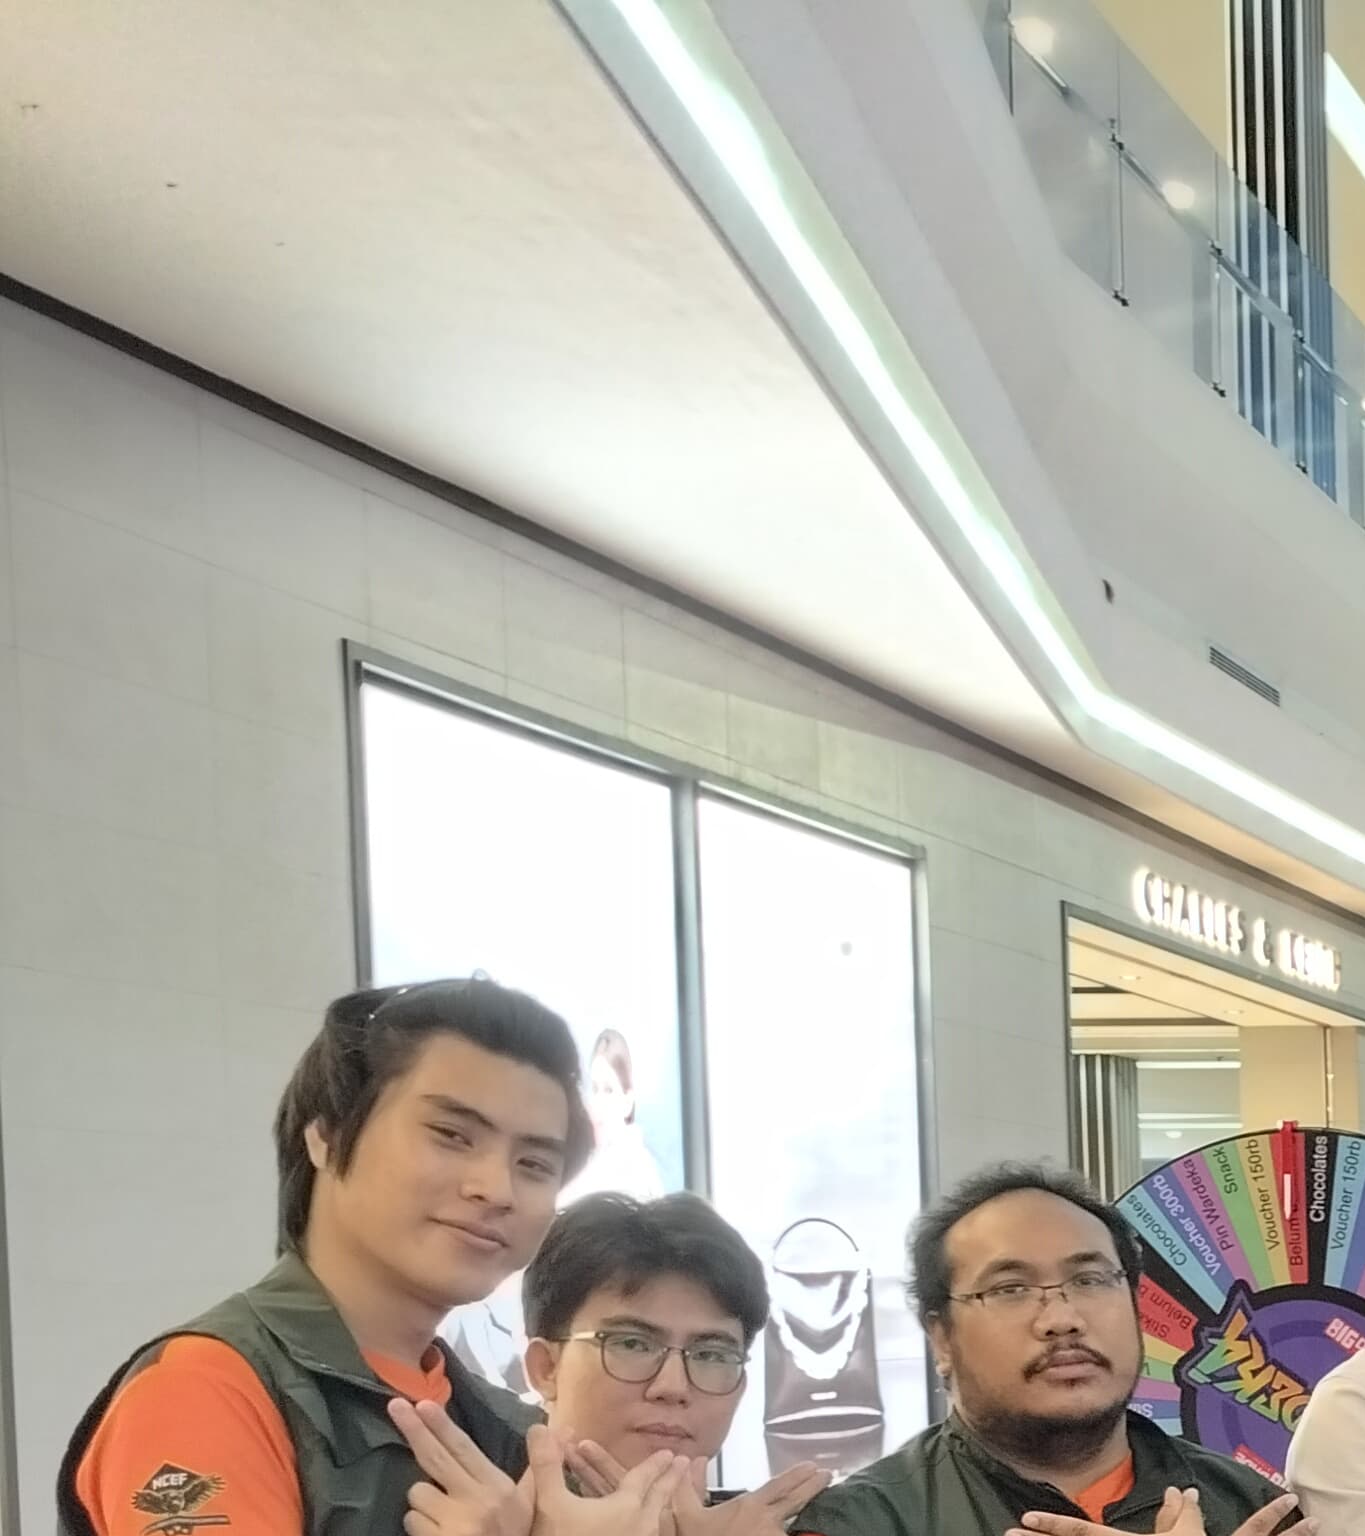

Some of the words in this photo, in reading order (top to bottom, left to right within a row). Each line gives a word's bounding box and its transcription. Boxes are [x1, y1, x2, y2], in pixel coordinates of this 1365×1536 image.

[1212, 1146, 1239, 1195] Snack
[1245, 1138, 1265, 1183] 150rb
[1309, 1135, 1329, 1223] Chocolates
[1152, 1174, 1185, 1217] 300rb
[1183, 1158, 1220, 1225] Wardeka
[1257, 1188, 1281, 1250] Voucher
[1331, 1189, 1354, 1251] Voucher
[1343, 1140, 1362, 1183] 150rb
[1126, 1194, 1188, 1266] Chocolates
[1180, 1217, 1222, 1276] Voucher
[1215, 1224, 1235, 1252] Pin
[152, 1472, 189, 1491] NCEF
